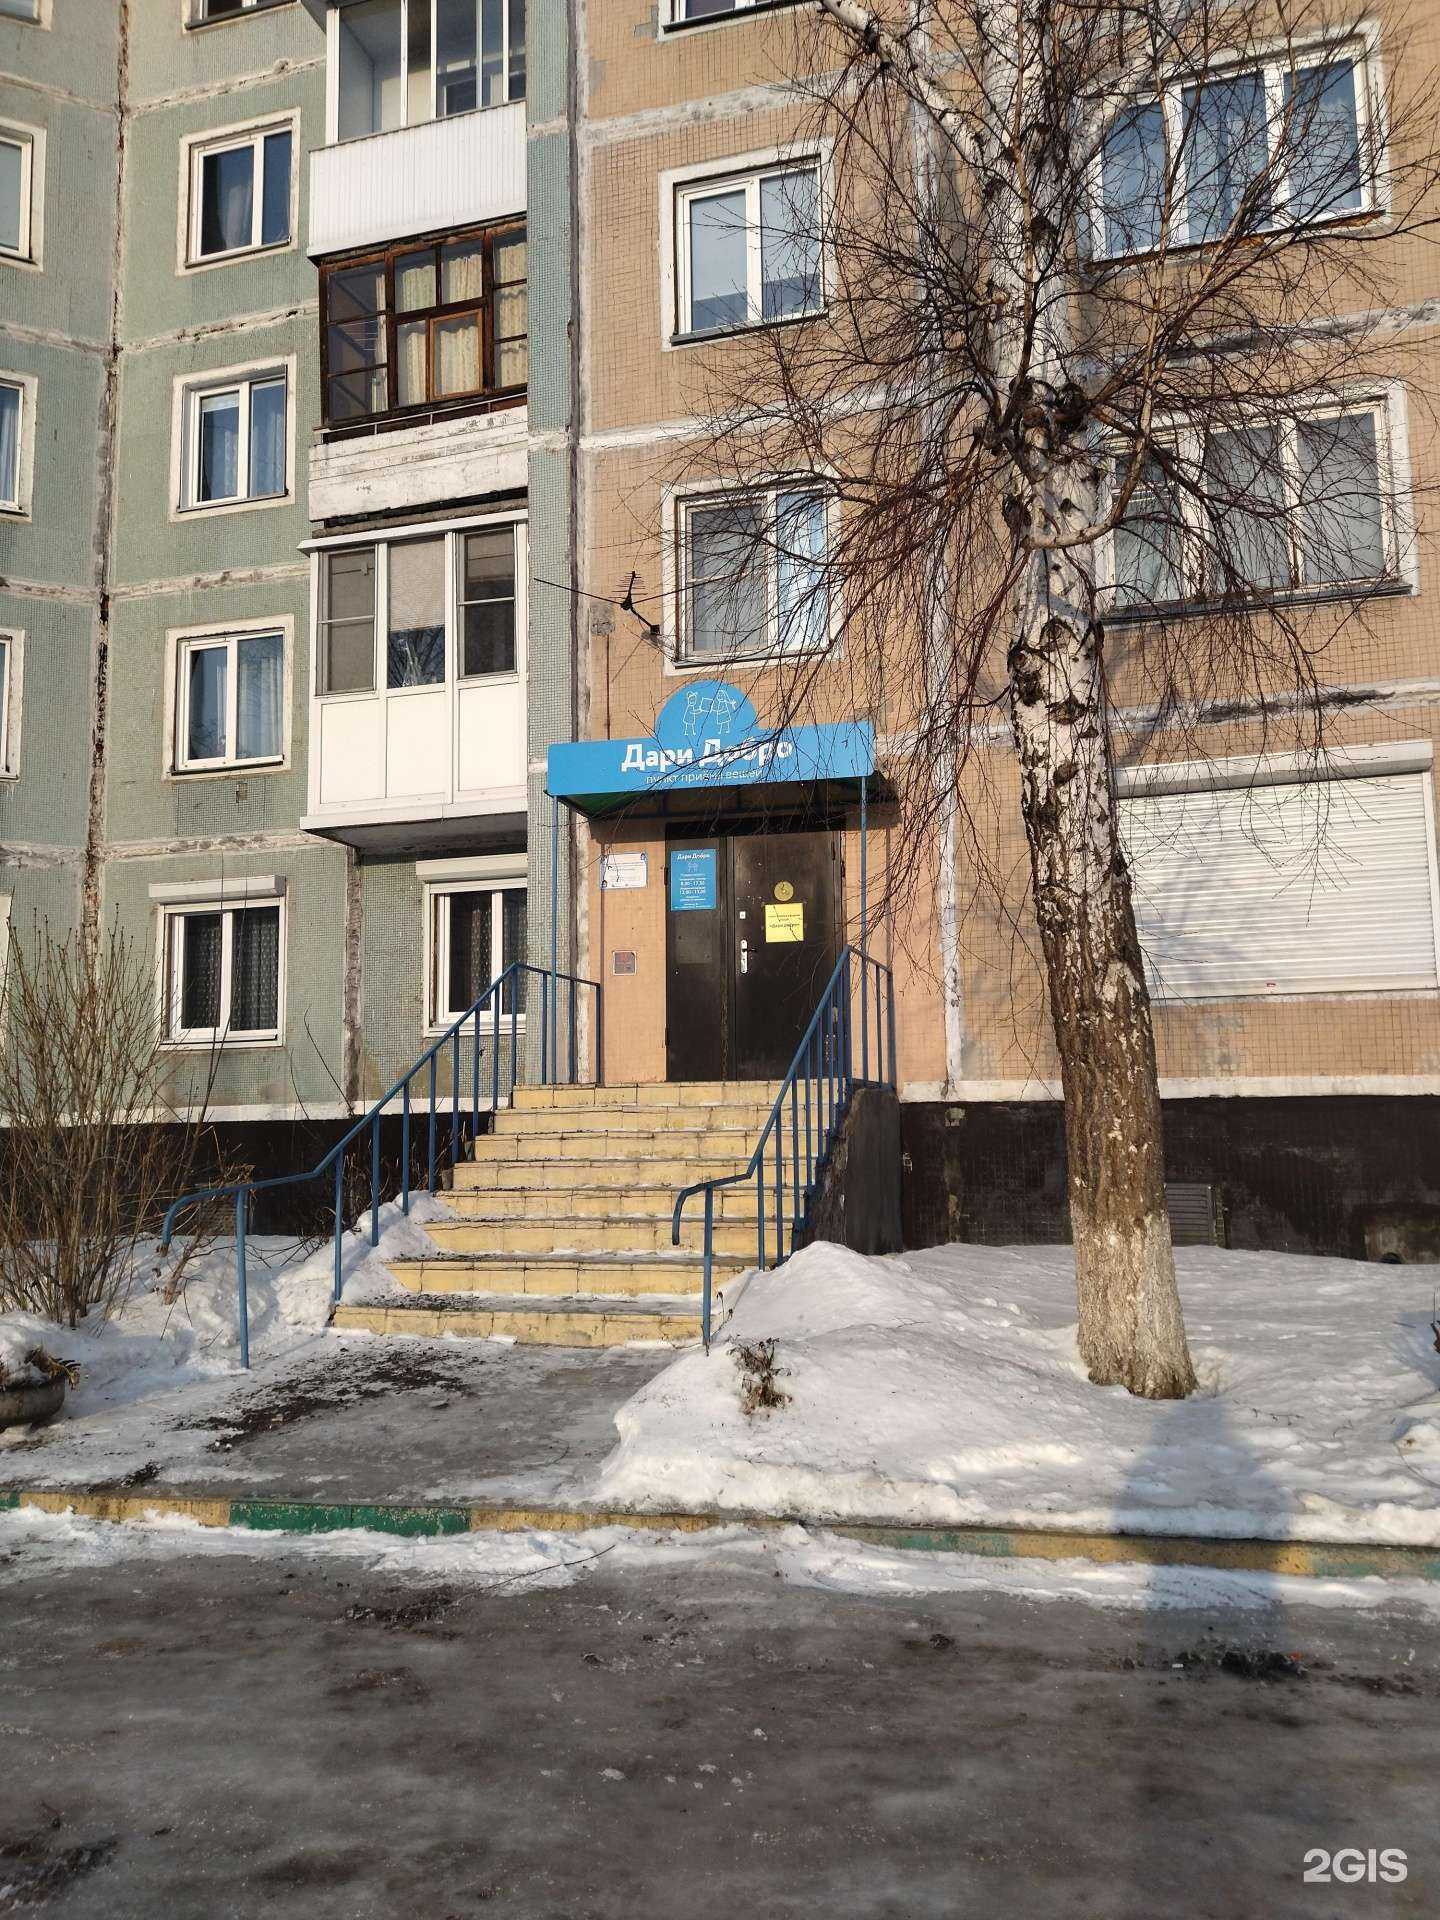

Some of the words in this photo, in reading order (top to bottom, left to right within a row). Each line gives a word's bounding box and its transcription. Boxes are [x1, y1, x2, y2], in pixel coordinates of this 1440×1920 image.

[621, 743, 693, 772] Дари
[698, 736, 793, 767] Добро
[646, 774, 679, 785] пункт
